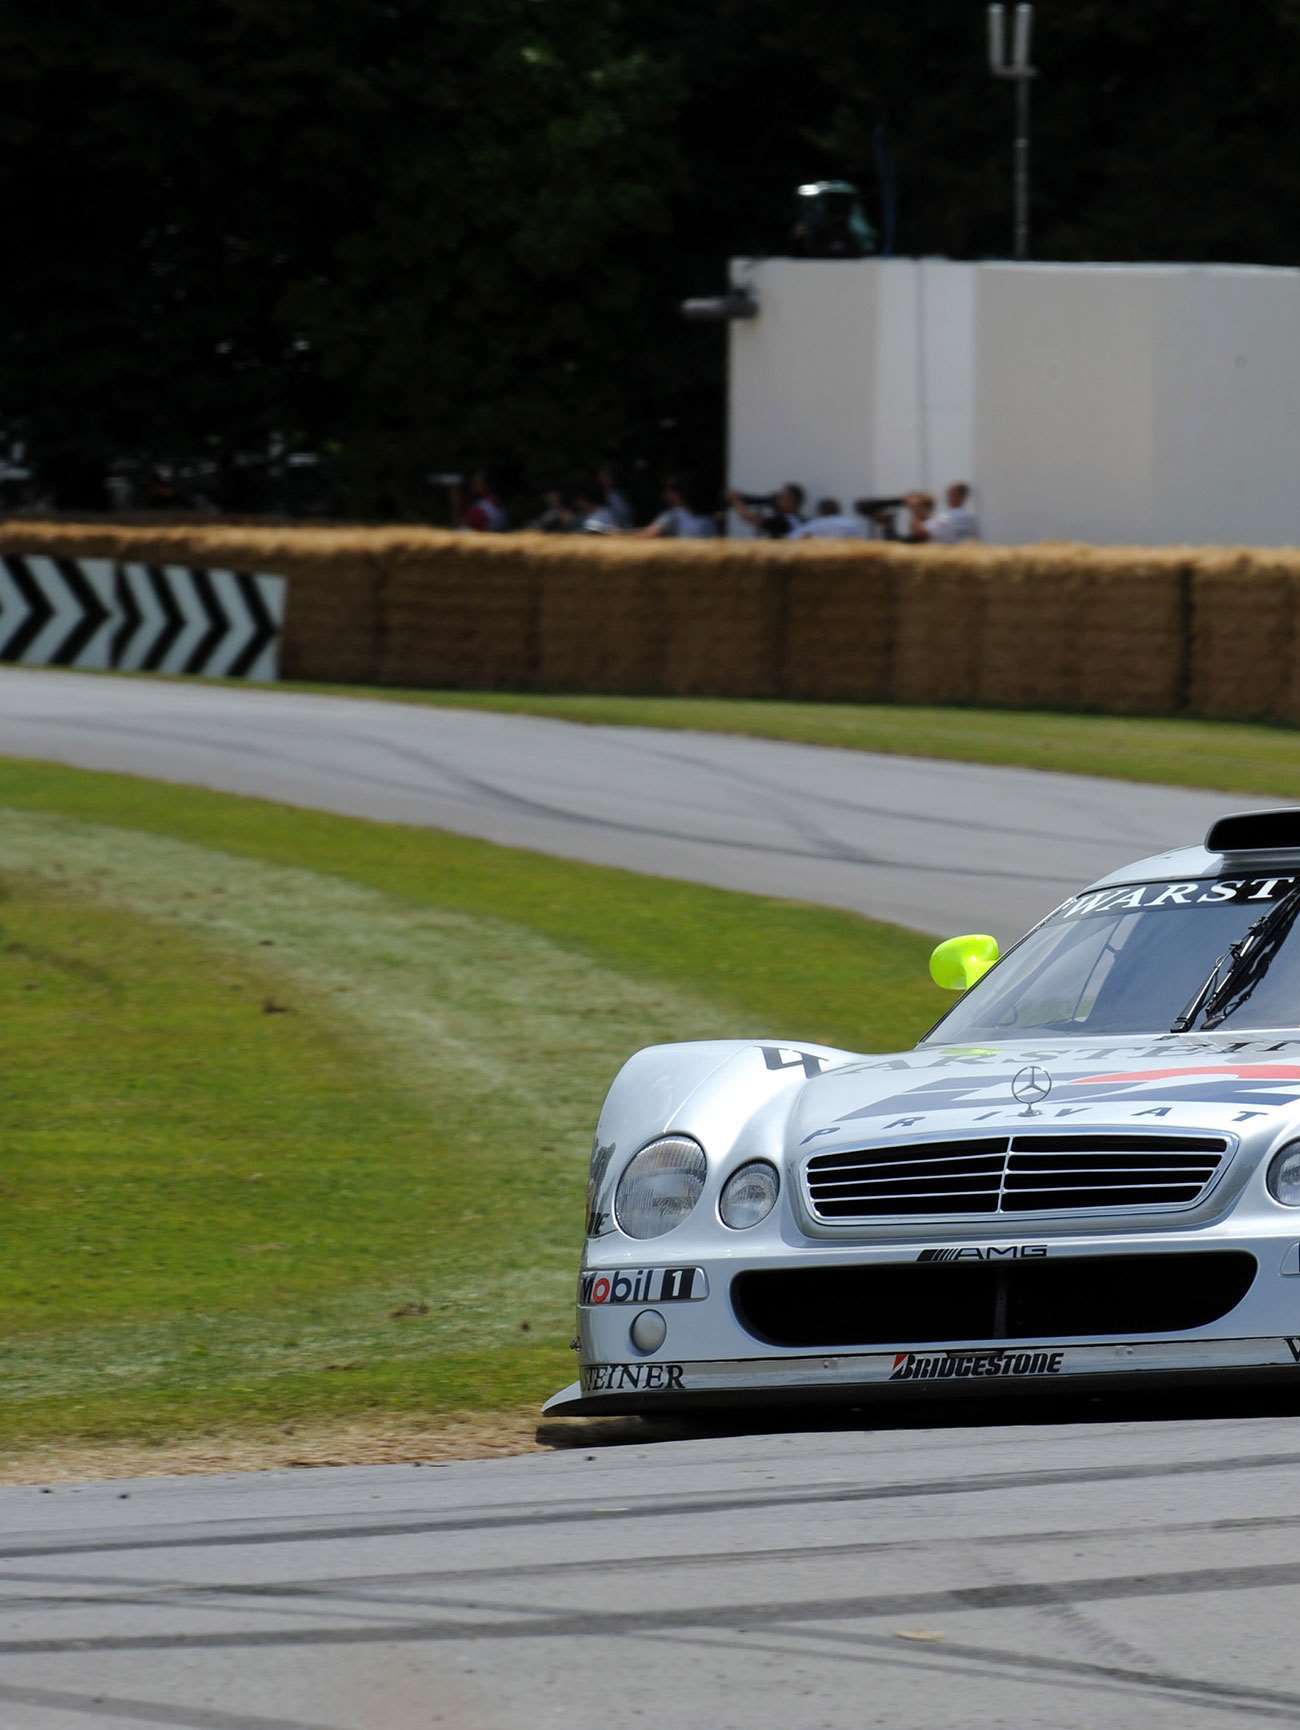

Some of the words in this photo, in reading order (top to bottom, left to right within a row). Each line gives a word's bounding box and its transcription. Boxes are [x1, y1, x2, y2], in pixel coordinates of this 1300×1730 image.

[799, 1106, 1269, 1146] PRIVAT
[952, 1245, 1048, 1260] AMG
[889, 1352, 1064, 1381] BRIDGESTONE
